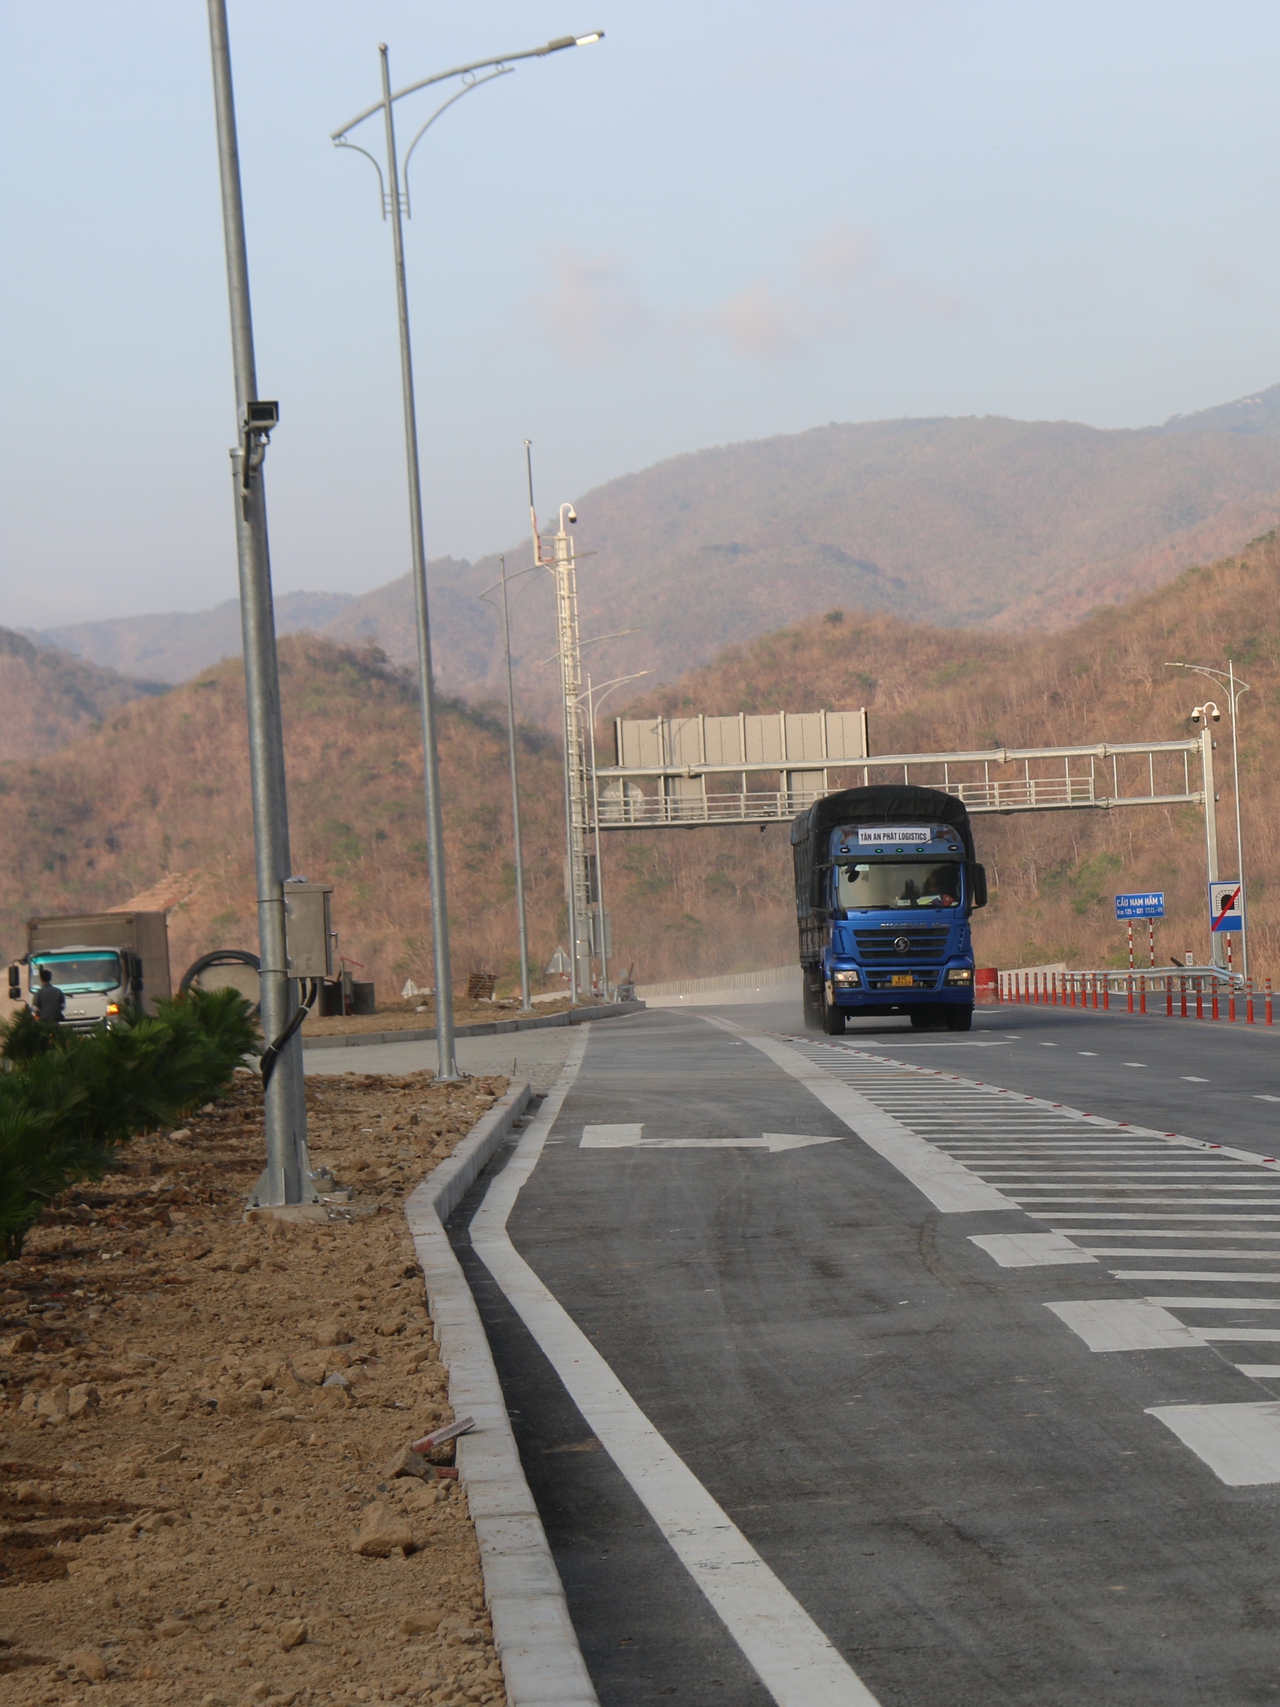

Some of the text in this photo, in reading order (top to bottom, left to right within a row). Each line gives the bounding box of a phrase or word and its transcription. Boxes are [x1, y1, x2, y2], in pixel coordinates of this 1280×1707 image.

[873, 832, 881, 841] AN
[898, 832, 927, 841] LOGISTICS
[1130, 898, 1143, 906] NAM
